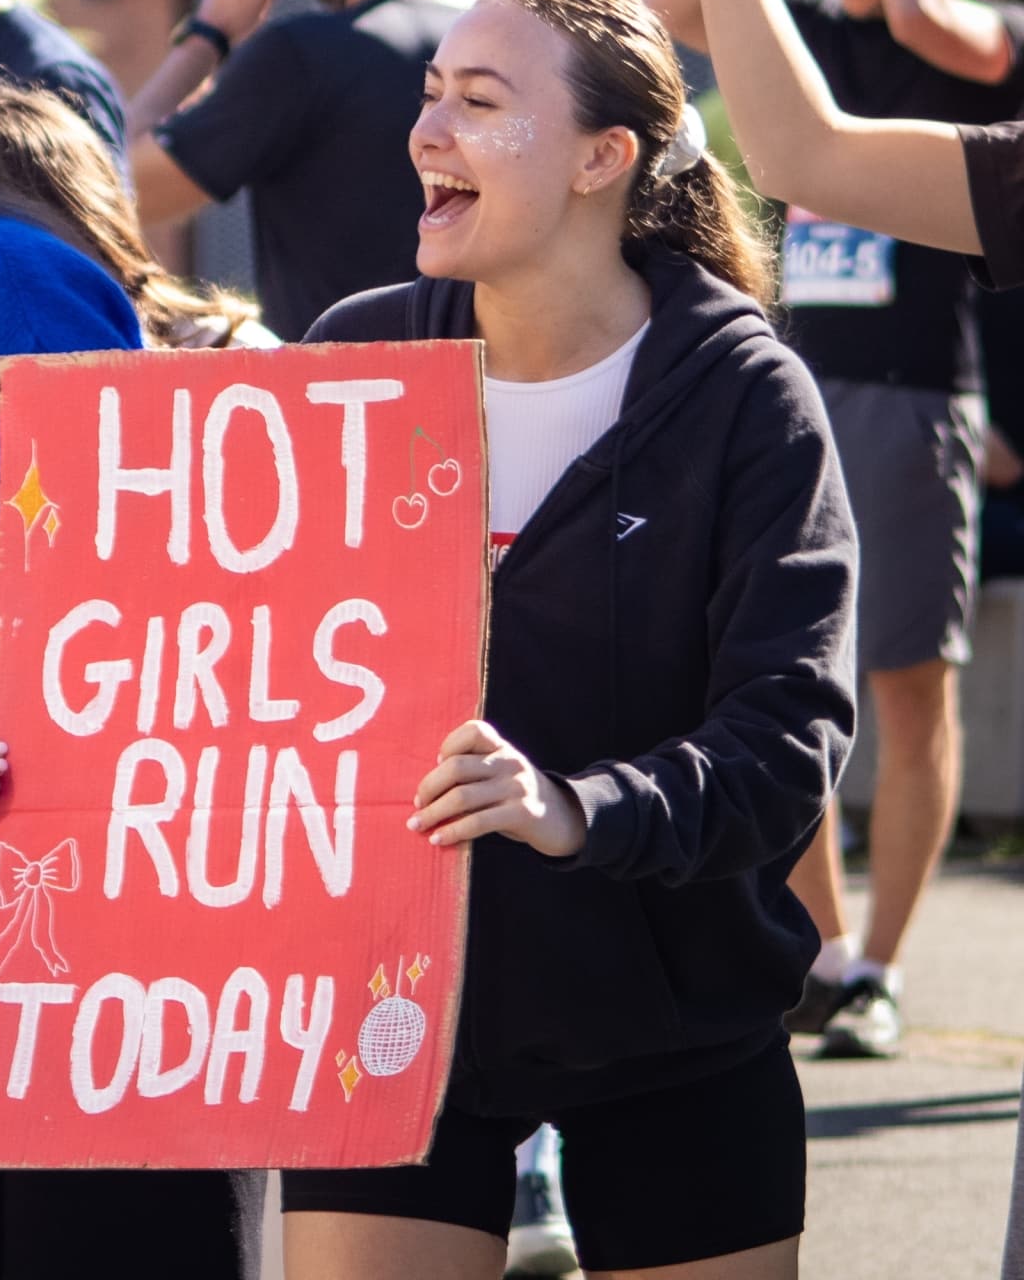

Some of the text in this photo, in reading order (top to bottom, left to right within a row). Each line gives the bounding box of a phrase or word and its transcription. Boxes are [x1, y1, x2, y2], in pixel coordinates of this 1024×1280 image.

[95, 378, 405, 574] HOT
[42, 598, 388, 742] GIRLS
[103, 737, 359, 909] RUN
